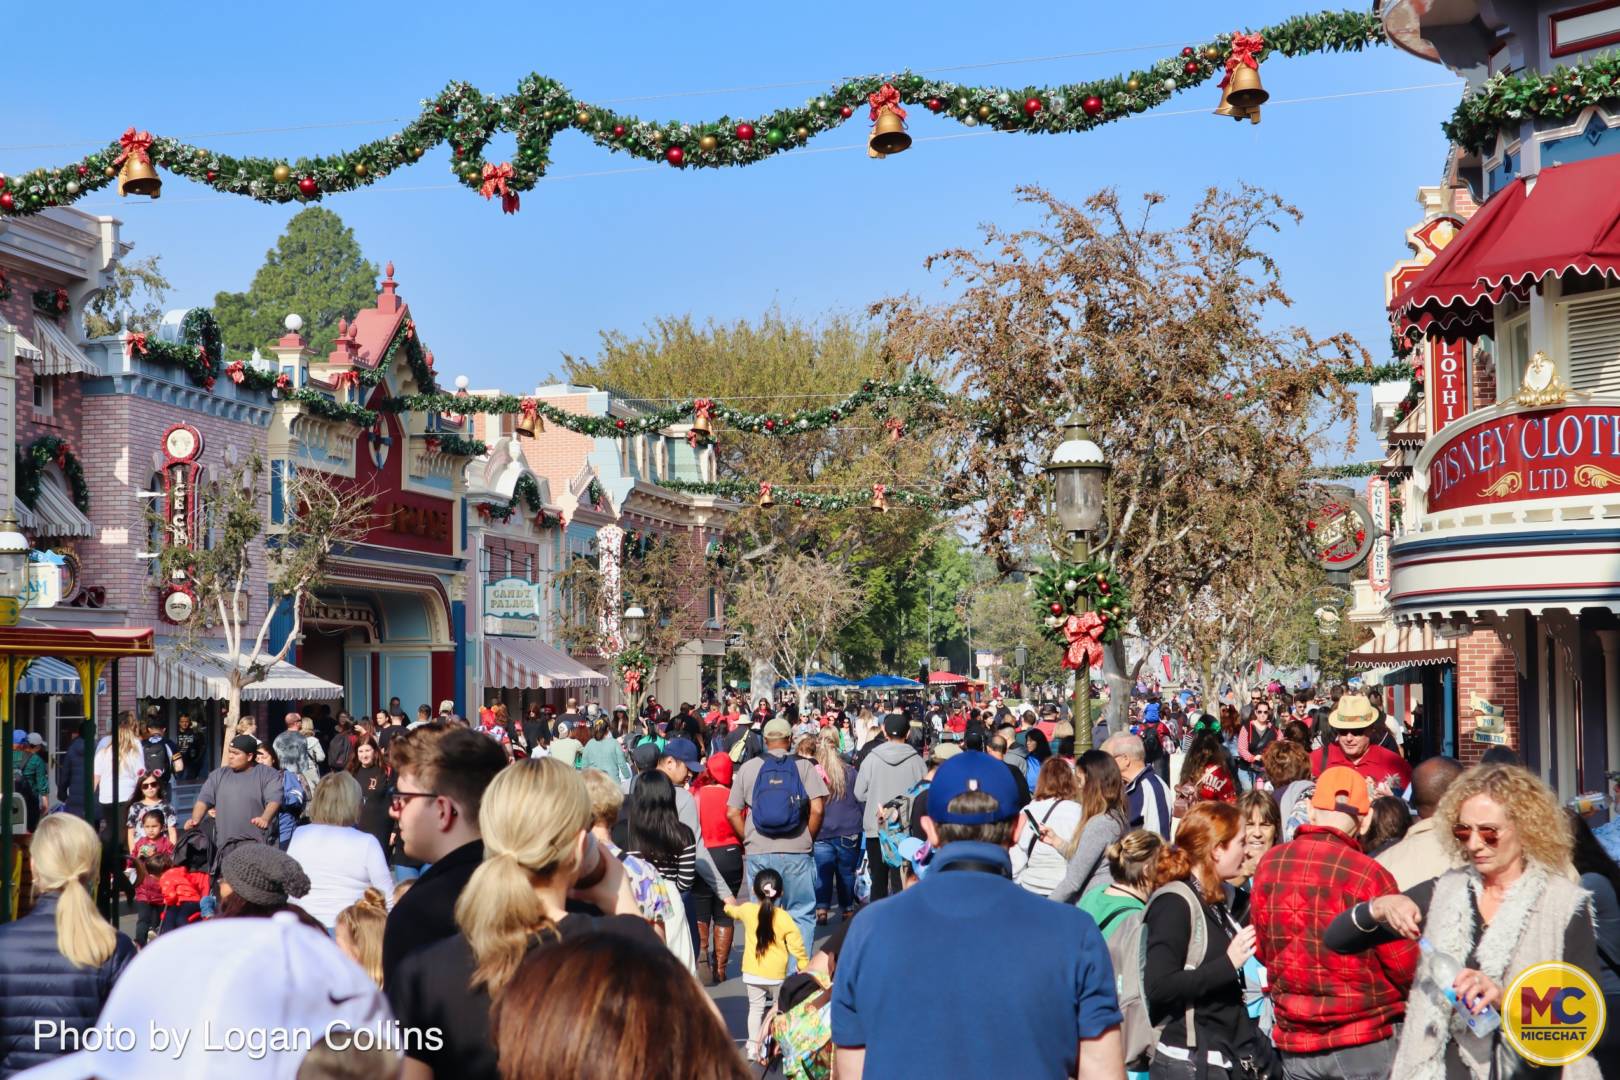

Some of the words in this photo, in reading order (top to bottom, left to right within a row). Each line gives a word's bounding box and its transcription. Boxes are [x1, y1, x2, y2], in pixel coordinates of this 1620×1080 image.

[1440, 341, 1457, 428] LOTHI
[1433, 423, 1514, 499] DISNEY
[173, 469, 186, 510] ICE
[1374, 488, 1384, 529] CHINA
[1374, 538, 1385, 576] LOSET
[490, 599, 534, 609] PALACE
[492, 589, 530, 599] CANDY
